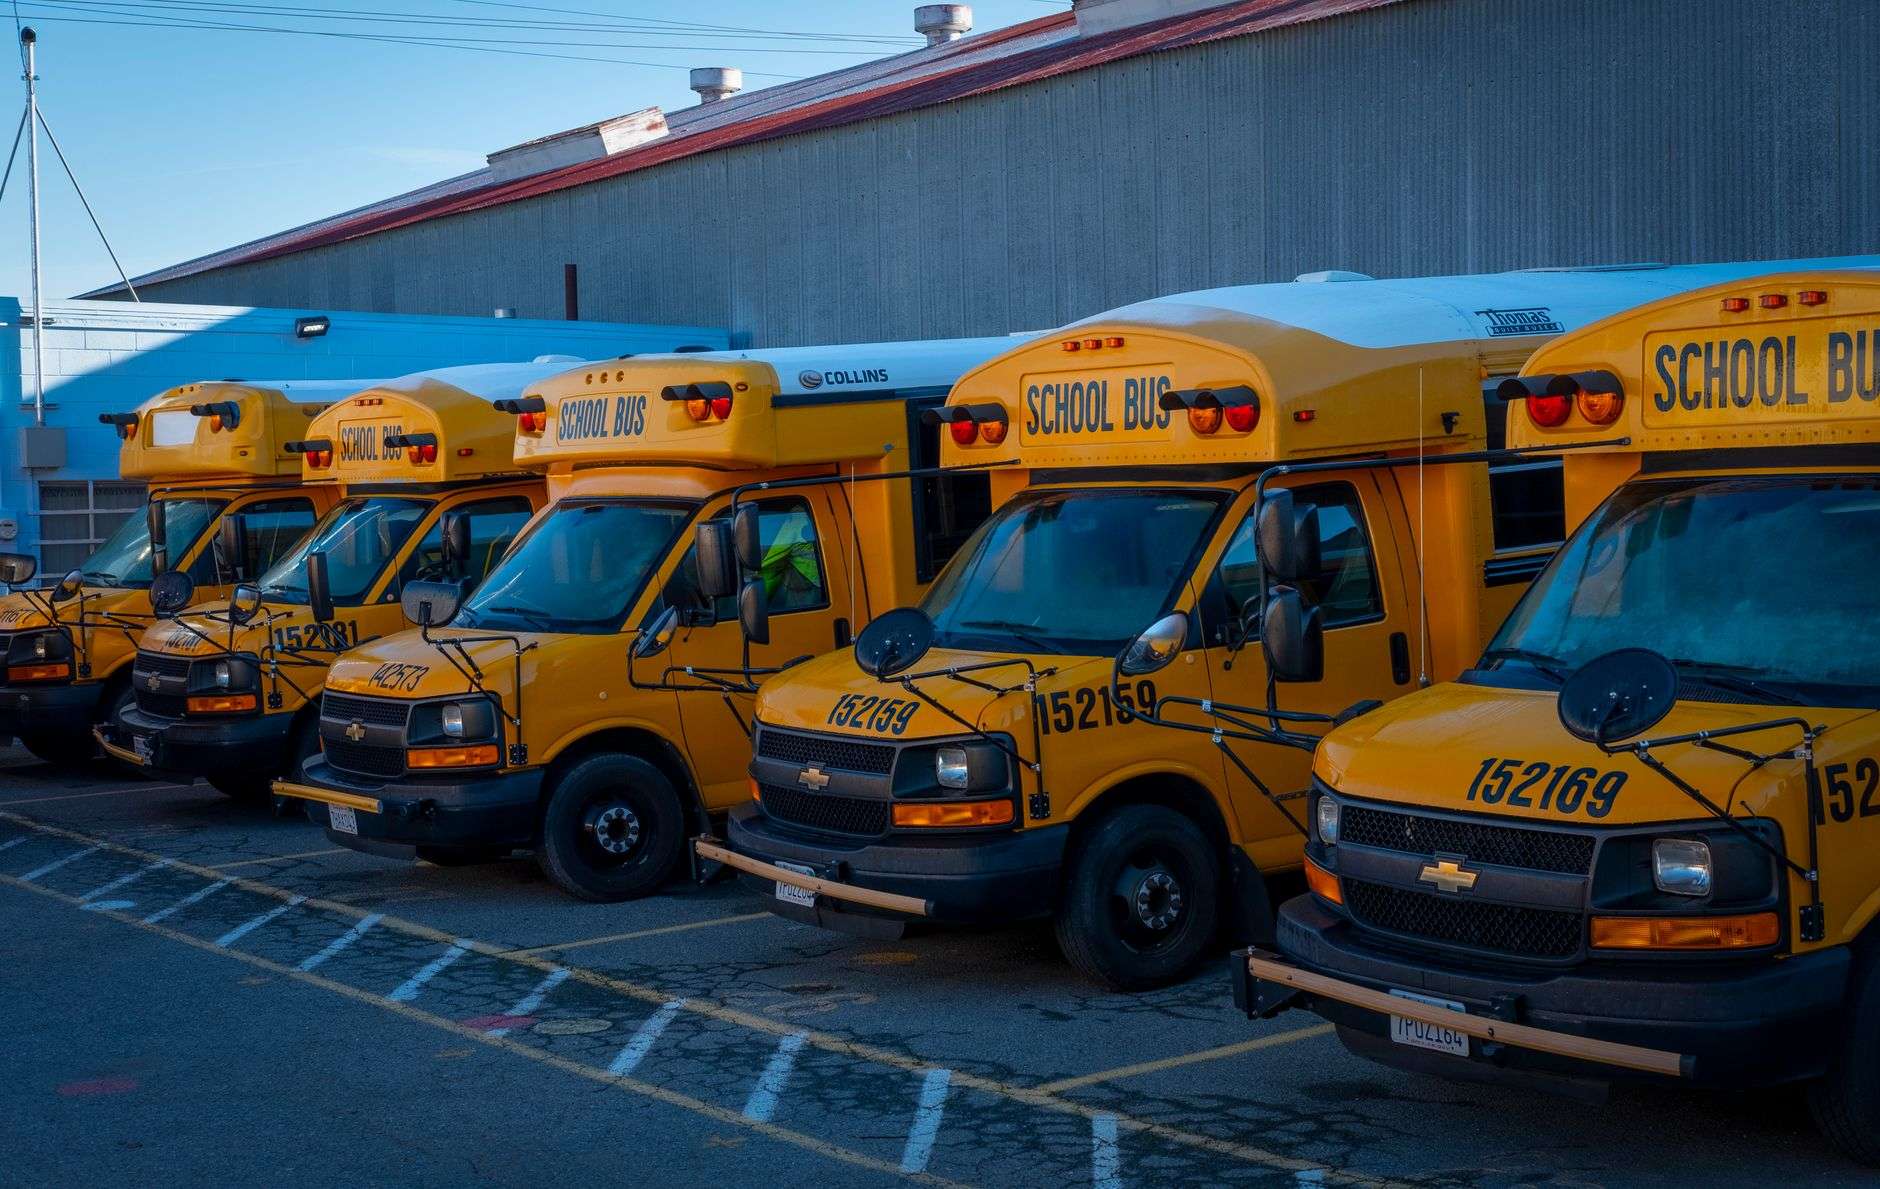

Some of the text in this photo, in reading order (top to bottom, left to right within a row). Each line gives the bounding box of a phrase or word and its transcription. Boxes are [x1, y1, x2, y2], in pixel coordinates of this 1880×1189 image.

[1474, 307, 1551, 325] Thomas
[824, 369, 889, 385] COLLINS
[1655, 334, 1809, 413] SCHOOL
[559, 395, 647, 441] SCHOOL BUS
[1026, 376, 1171, 435] SCHOOL BUS
[341, 427, 377, 461] SCHOOL
[827, 692, 920, 735] 152159
[1037, 679, 1156, 735] 152159
[1467, 757, 1628, 818] 152169
